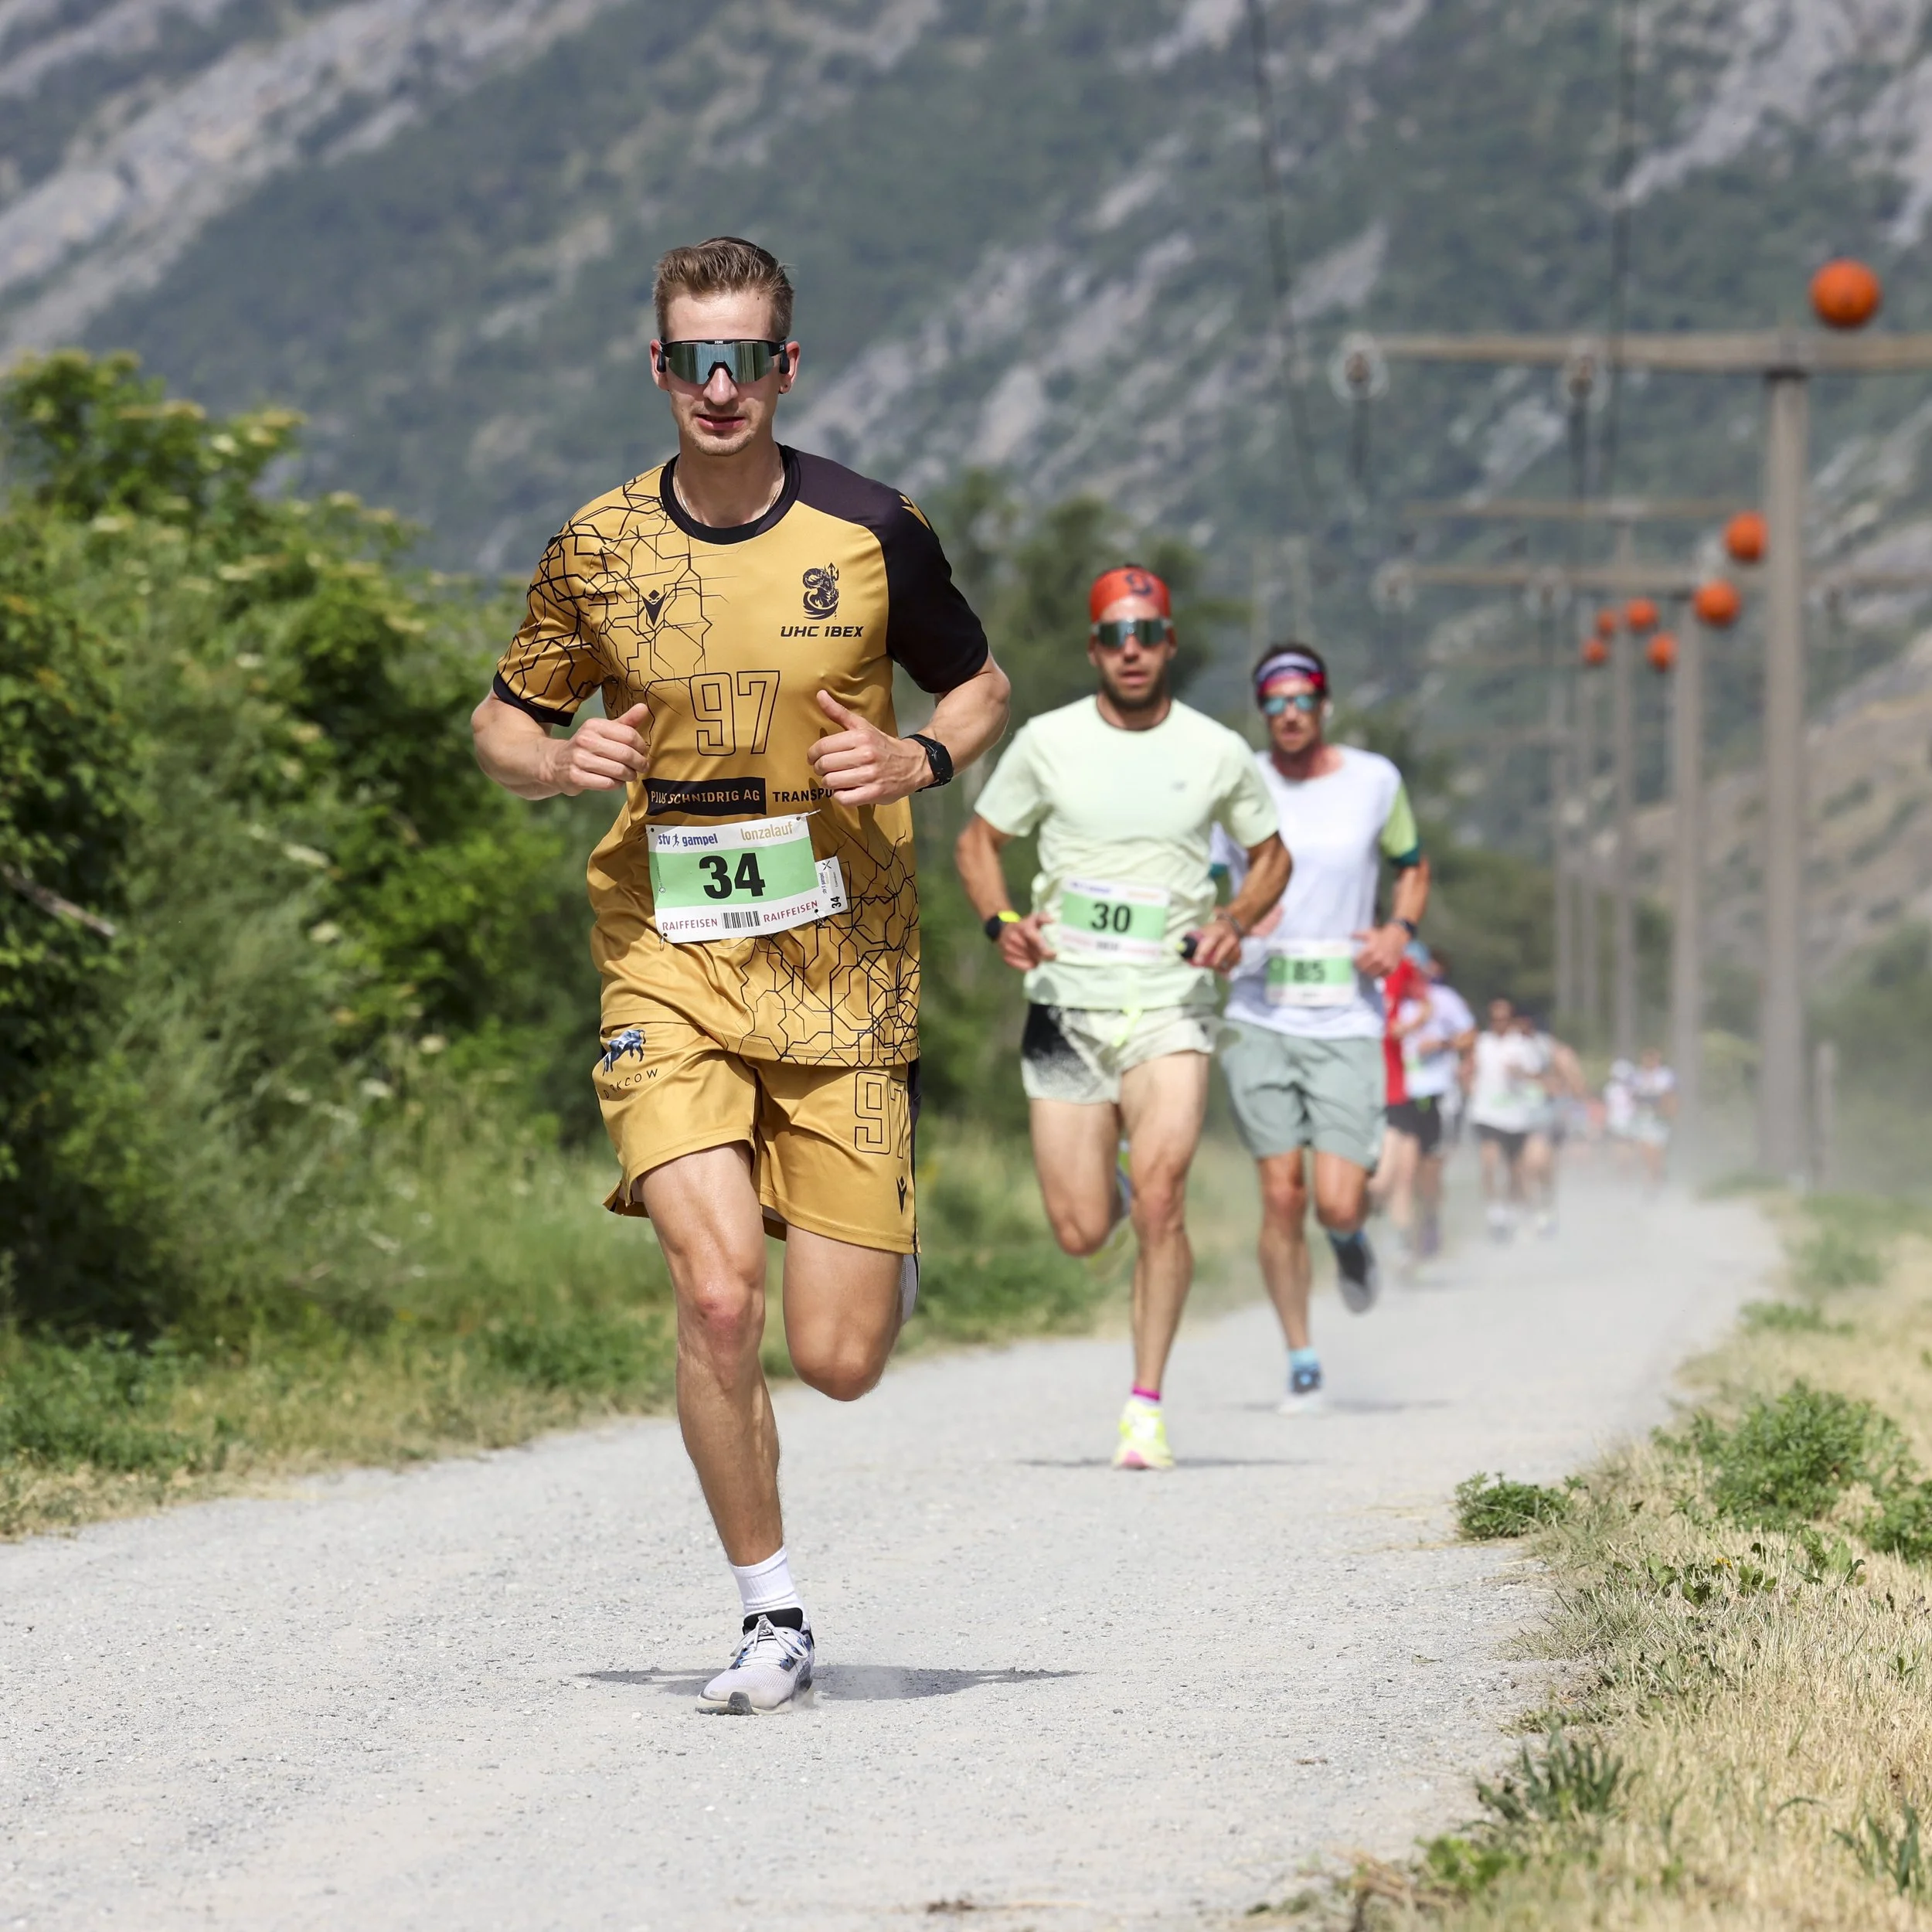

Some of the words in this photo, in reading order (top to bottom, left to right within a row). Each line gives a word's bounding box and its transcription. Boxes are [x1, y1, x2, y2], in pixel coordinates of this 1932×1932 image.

[781, 626, 819, 637] UHC
[825, 626, 864, 637] IBEX
[689, 671, 781, 757] 97
[651, 791, 666, 804] PIUS
[668, 791, 740, 804] SCHNIDRIG
[743, 789, 760, 801] AG
[740, 821, 793, 841] lonzalauf
[658, 834, 670, 845] stv
[682, 833, 718, 847] gampel
[699, 852, 766, 900] 34
[764, 900, 818, 922] RAIFFEISEN
[830, 896, 842, 909] 34
[662, 918, 718, 930] RAIFFEISEN
[1090, 903, 1131, 933] 30
